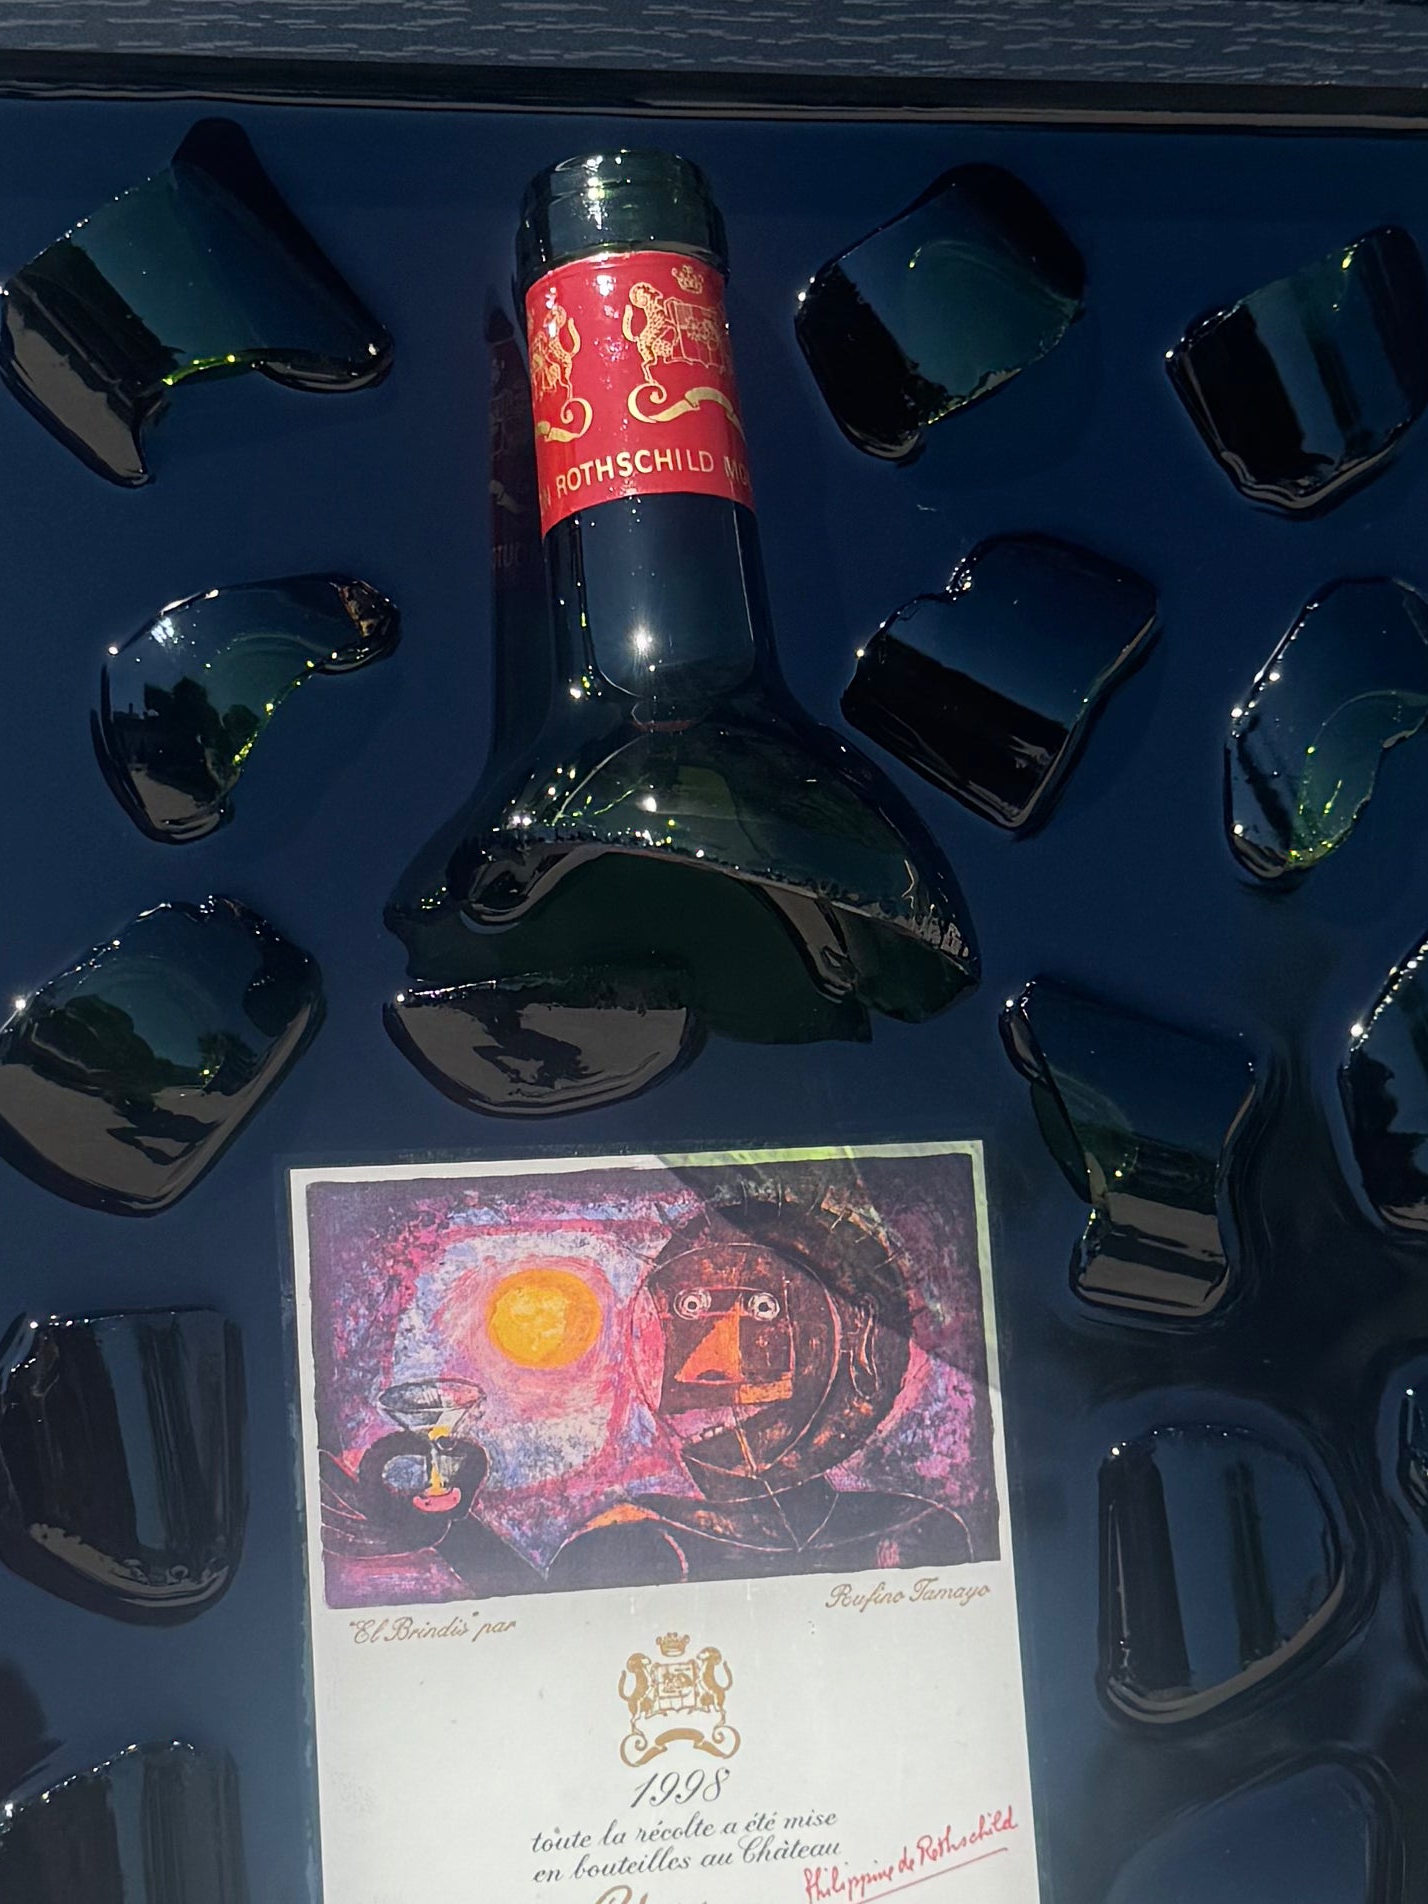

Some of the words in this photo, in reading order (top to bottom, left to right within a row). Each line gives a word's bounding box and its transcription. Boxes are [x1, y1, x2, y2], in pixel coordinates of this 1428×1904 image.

[555, 447, 715, 498] ROTHSCHILD
[824, 1580, 905, 1613] Rufino
[908, 1576, 991, 1607] Tamayo
[470, 1620, 517, 1643] par
[629, 1768, 730, 1809] 1998
[531, 1826, 592, 1853] toute
[602, 1818, 627, 1846] la
[635, 1810, 714, 1843] récolte
[722, 1821, 738, 1835] a
[744, 1811, 776, 1833] été
[783, 1812, 836, 1829] mise
[532, 1868, 561, 1883] en
[573, 1845, 690, 1879] bouteilles
[699, 1852, 733, 1868] au
[737, 1834, 840, 1863] Château
